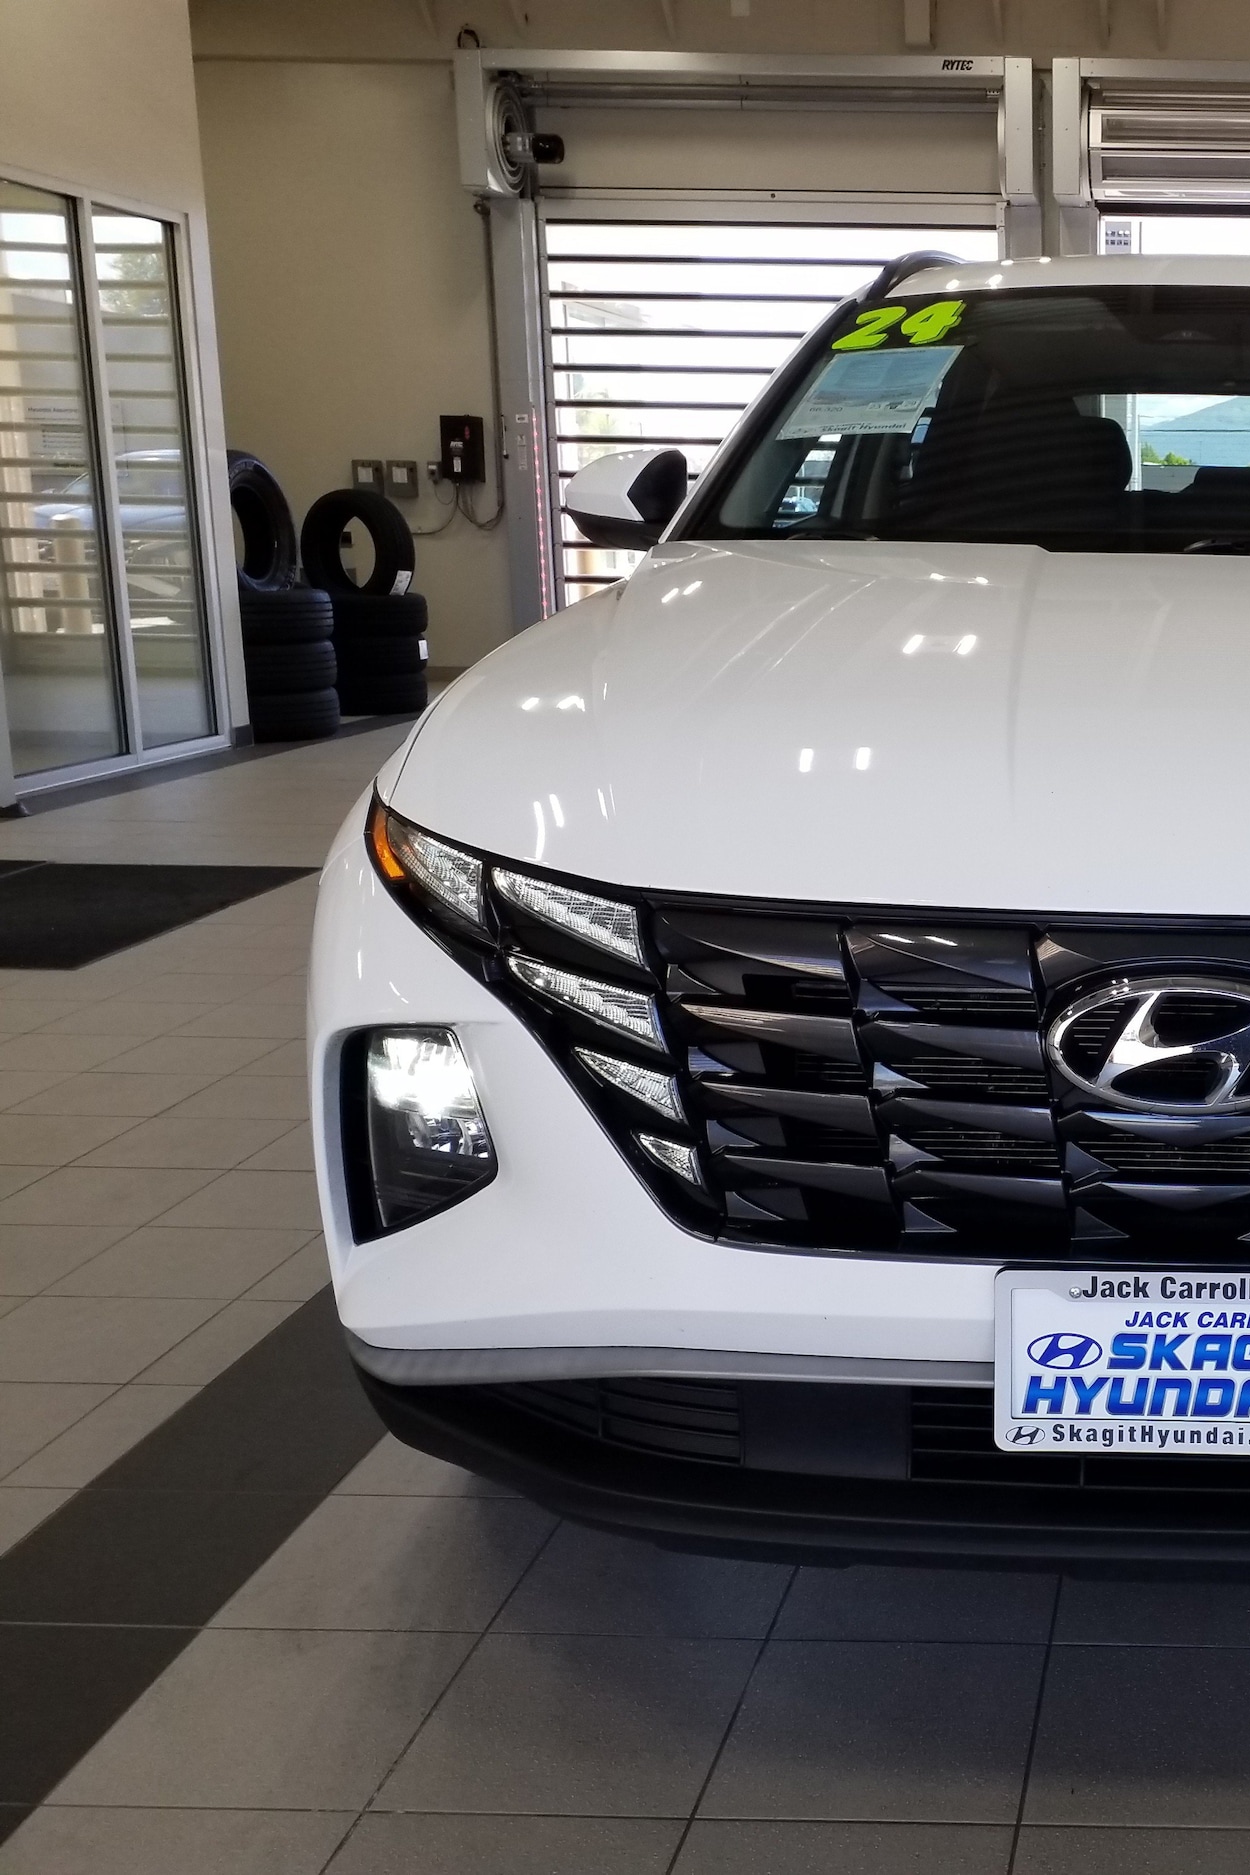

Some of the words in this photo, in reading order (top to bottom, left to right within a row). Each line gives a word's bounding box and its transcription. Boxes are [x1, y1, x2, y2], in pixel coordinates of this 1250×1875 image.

[942, 59, 974, 71] RYTEC
[831, 300, 967, 350] 24
[1082, 1276, 1150, 1299] Jack
[1125, 1311, 1191, 1328] JACK
